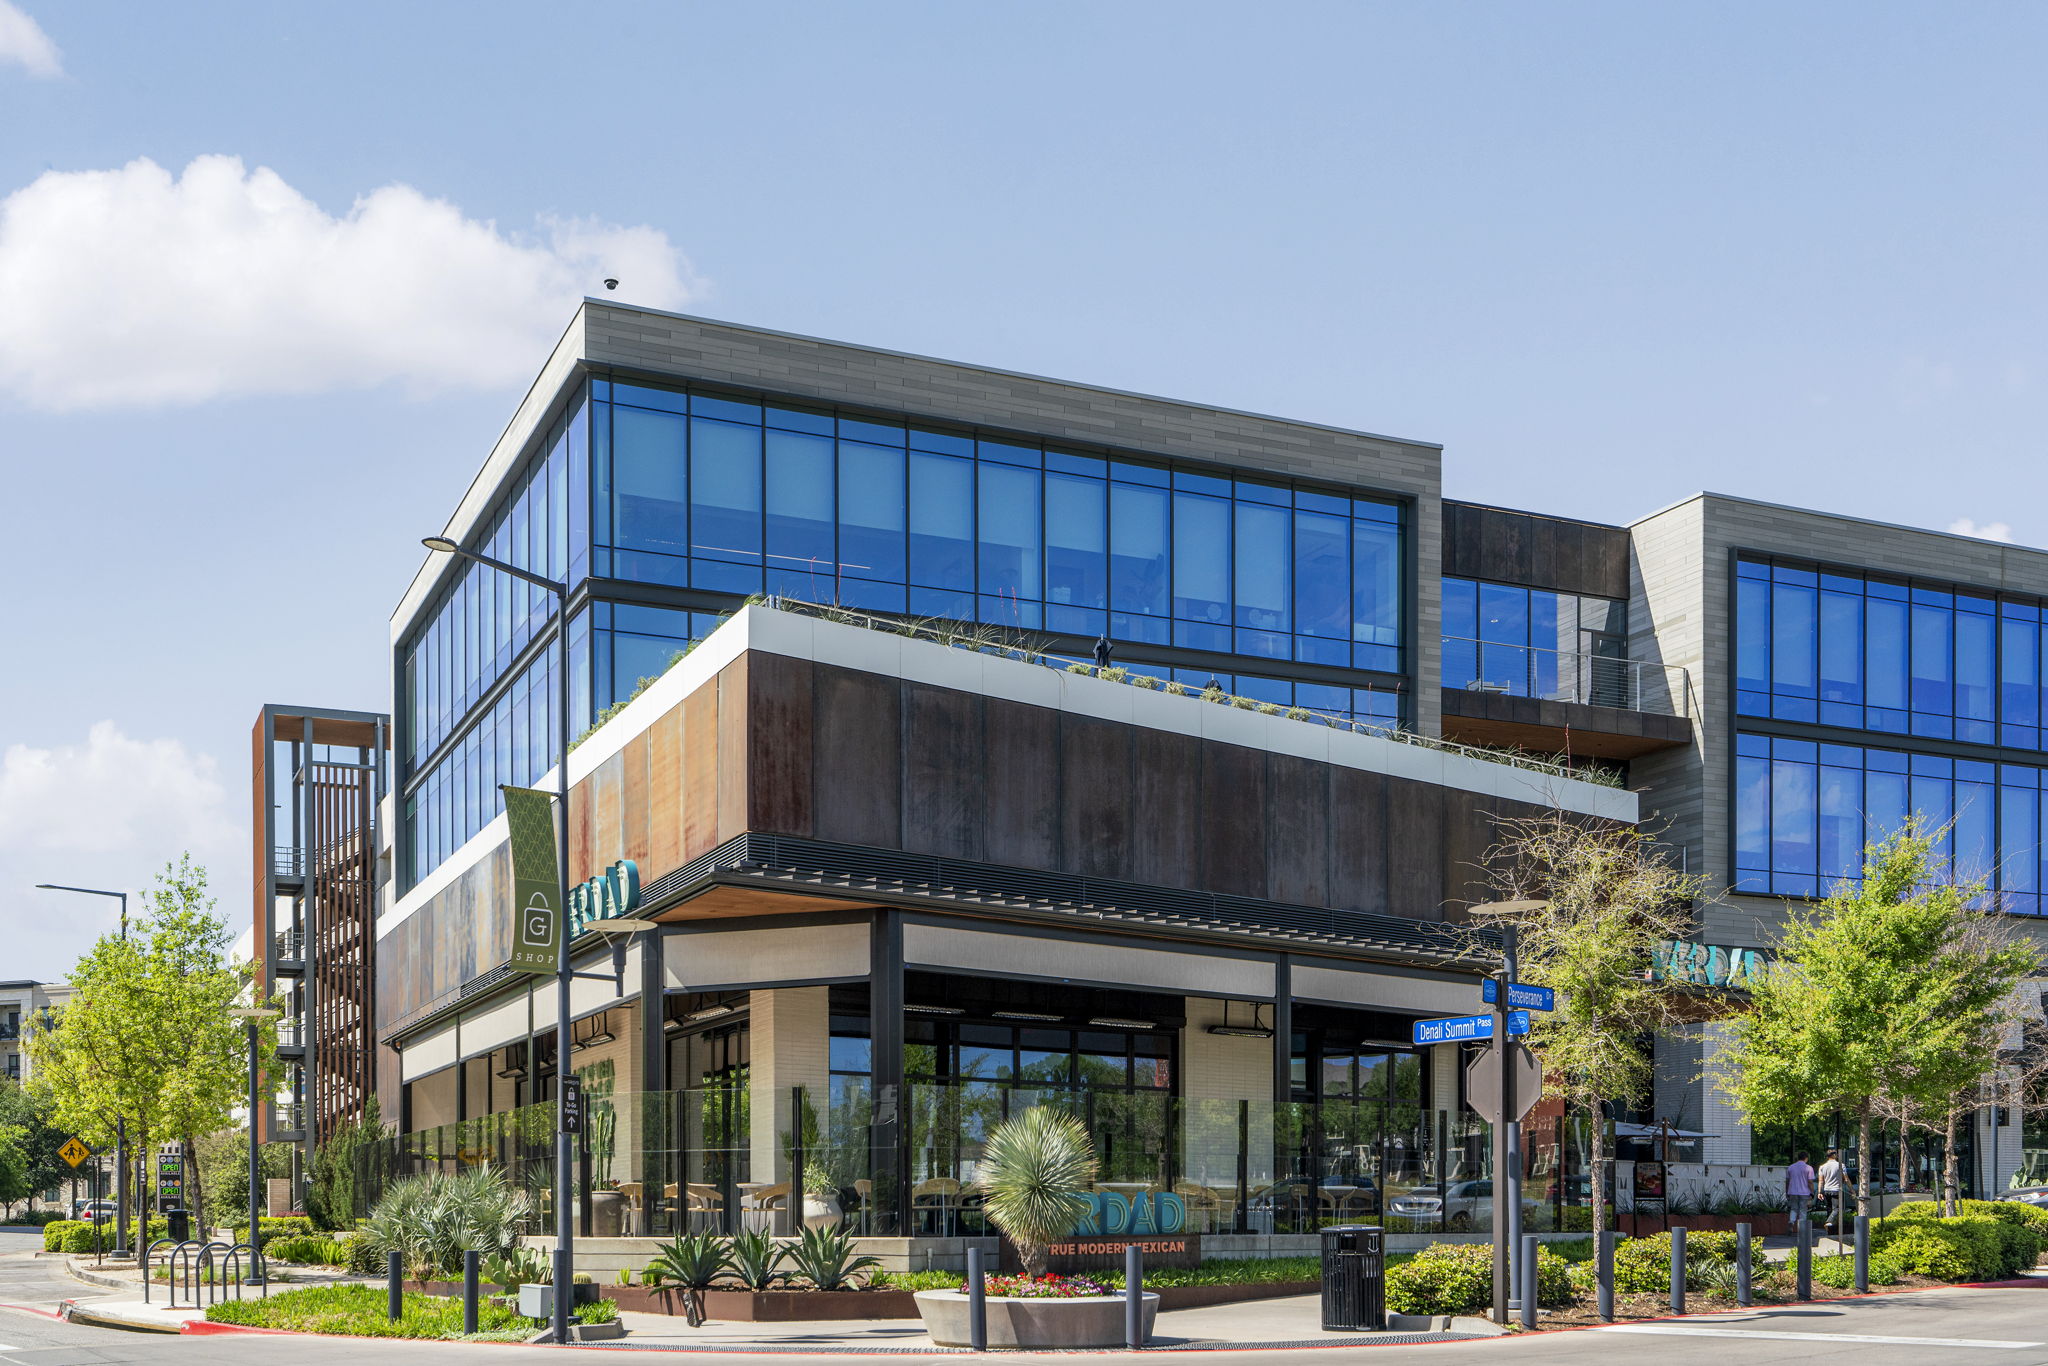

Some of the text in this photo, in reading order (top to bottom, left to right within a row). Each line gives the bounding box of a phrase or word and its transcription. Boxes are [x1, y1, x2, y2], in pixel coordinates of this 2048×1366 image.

[568, 859, 641, 939] ERDAD
[529, 916, 548, 936] G
[515, 952, 555, 964] SHOP
[1508, 986, 1543, 1007] Perseverance
[1420, 1022, 1443, 1041] Denali
[1445, 1020, 1476, 1039] Summit
[1477, 1018, 1492, 1028] Pass
[564, 1108, 579, 1116] Parking
[162, 1187, 179, 1195] OPEN
[1066, 1191, 1185, 1235] RDAD
[1048, 1243, 1076, 1256] RUE
